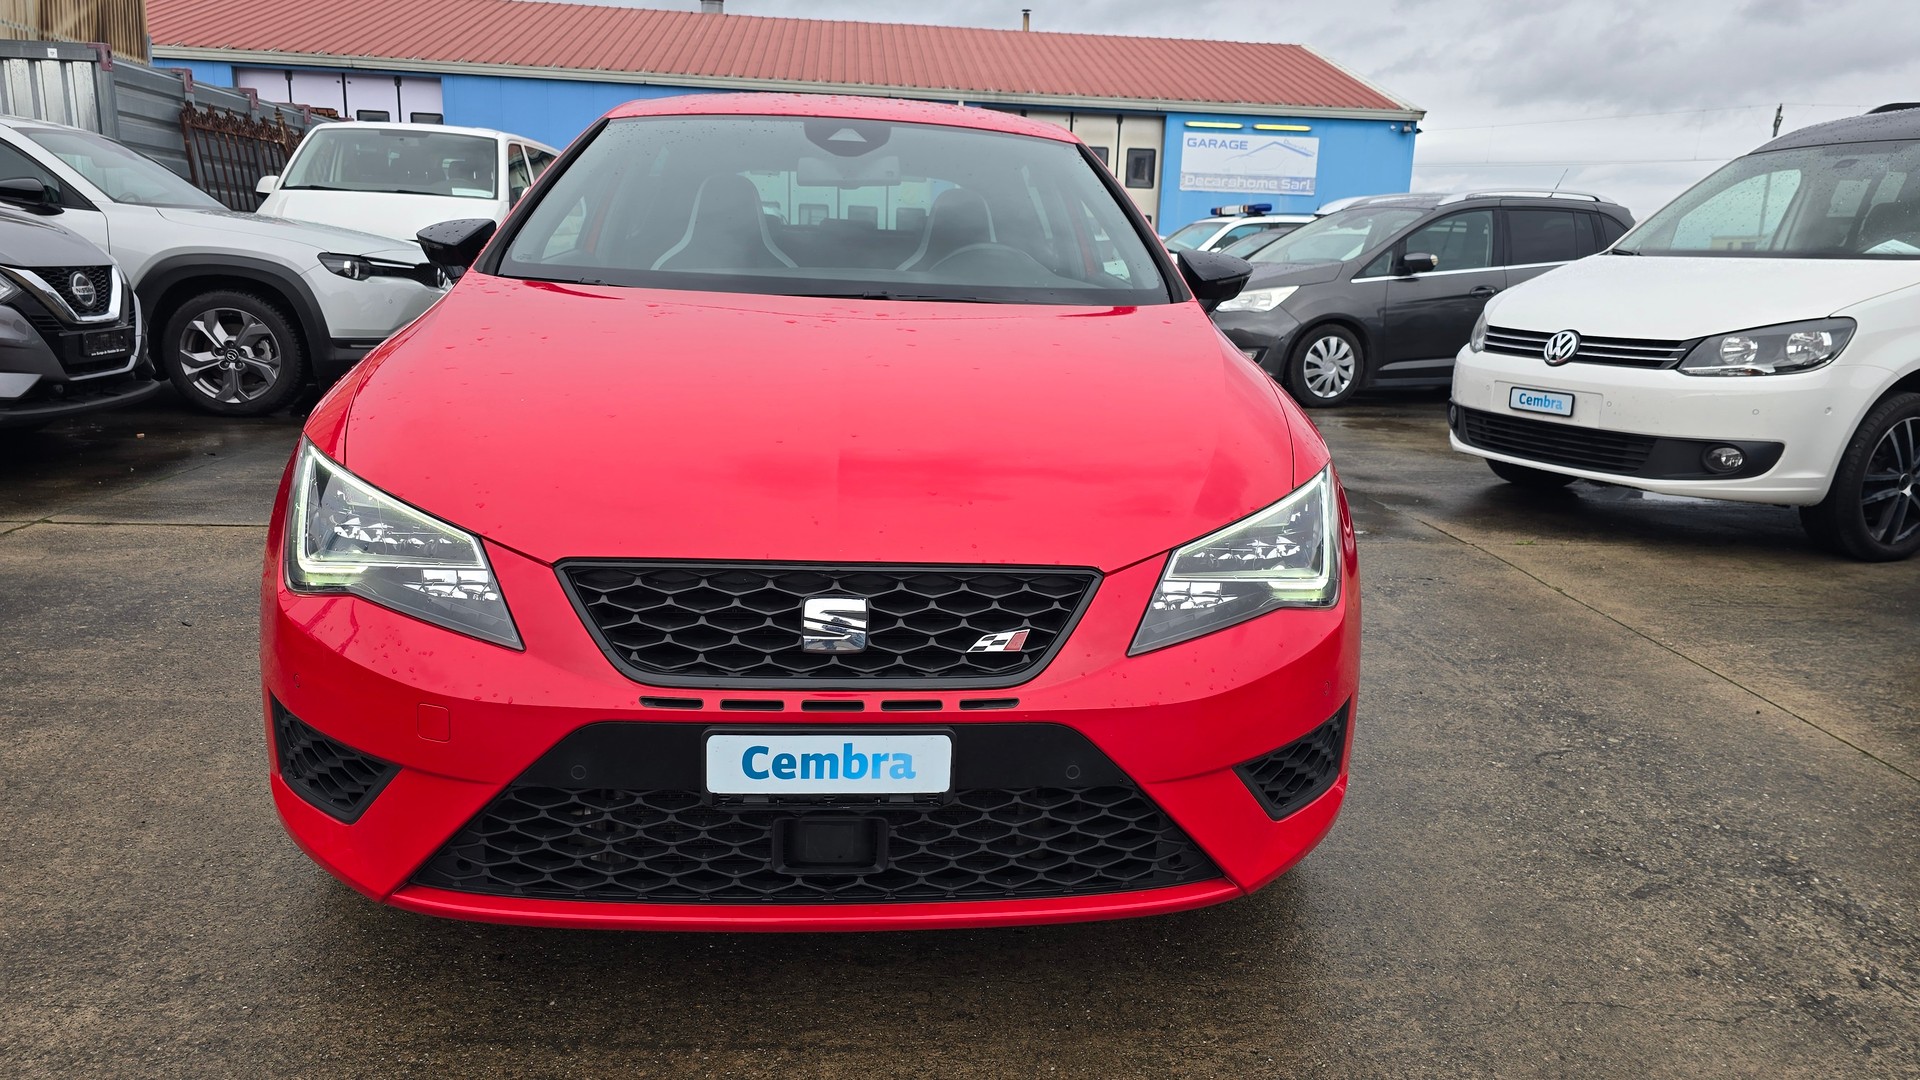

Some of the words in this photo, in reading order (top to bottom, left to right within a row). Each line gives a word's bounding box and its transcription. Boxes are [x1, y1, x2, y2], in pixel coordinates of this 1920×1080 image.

[1187, 138, 1248, 150] GARAGE
[1184, 174, 1278, 189] Decarshome
[1281, 178, 1310, 190] Sarl
[1518, 392, 1563, 410] Cembra
[741, 742, 916, 780] Cembra
